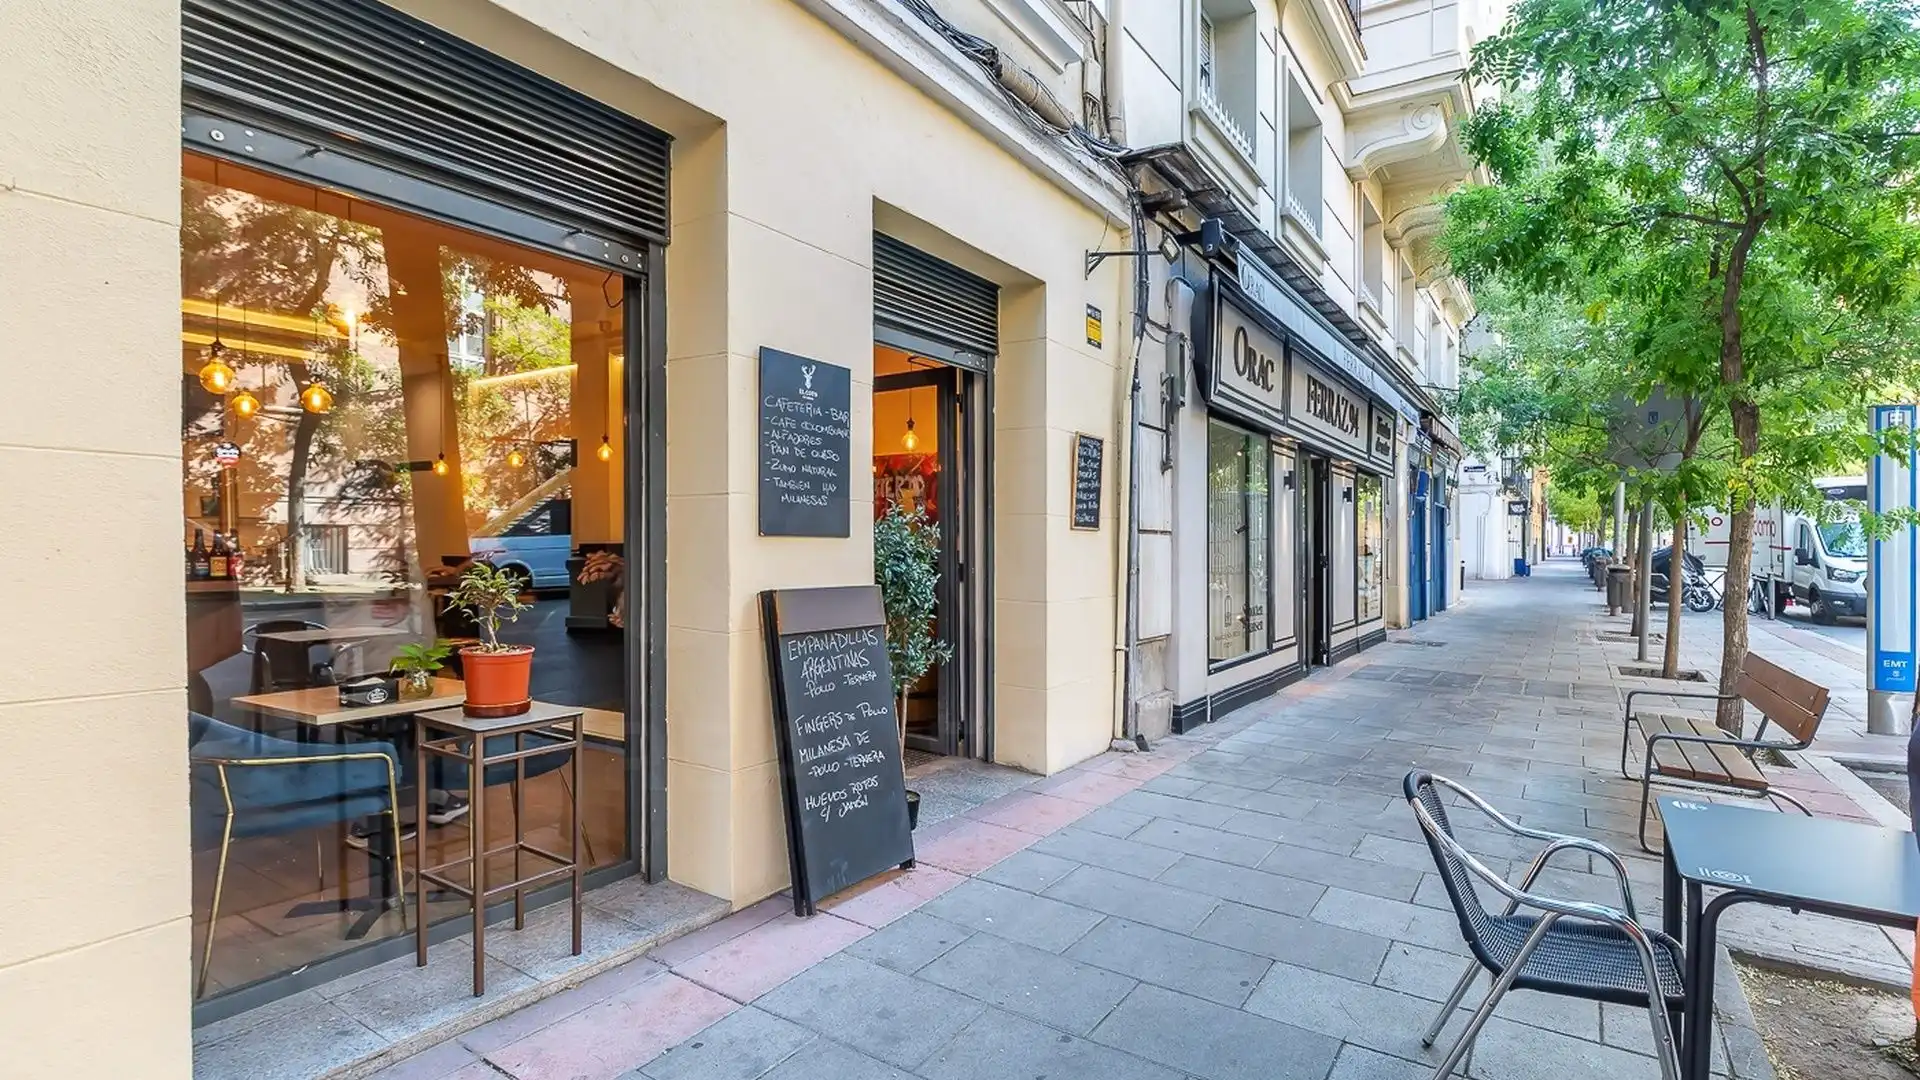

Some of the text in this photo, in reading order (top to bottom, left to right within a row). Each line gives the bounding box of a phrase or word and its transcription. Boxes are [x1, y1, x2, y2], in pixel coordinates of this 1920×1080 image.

[1233, 326, 1275, 393] ORAC
[764, 395, 822, 418] CAFETERIA
[830, 407, 850, 428] BAR
[794, 446, 807, 458] DE
[787, 629, 879, 661] EMPANADILLAS
[801, 648, 870, 683] ARGENTINAS
[1883, 659, 1908, 669] EMT
[794, 711, 844, 737] FINGERS
[798, 730, 871, 766] MILANESA DE
[804, 775, 879, 812] HUEVOS ROTOS
